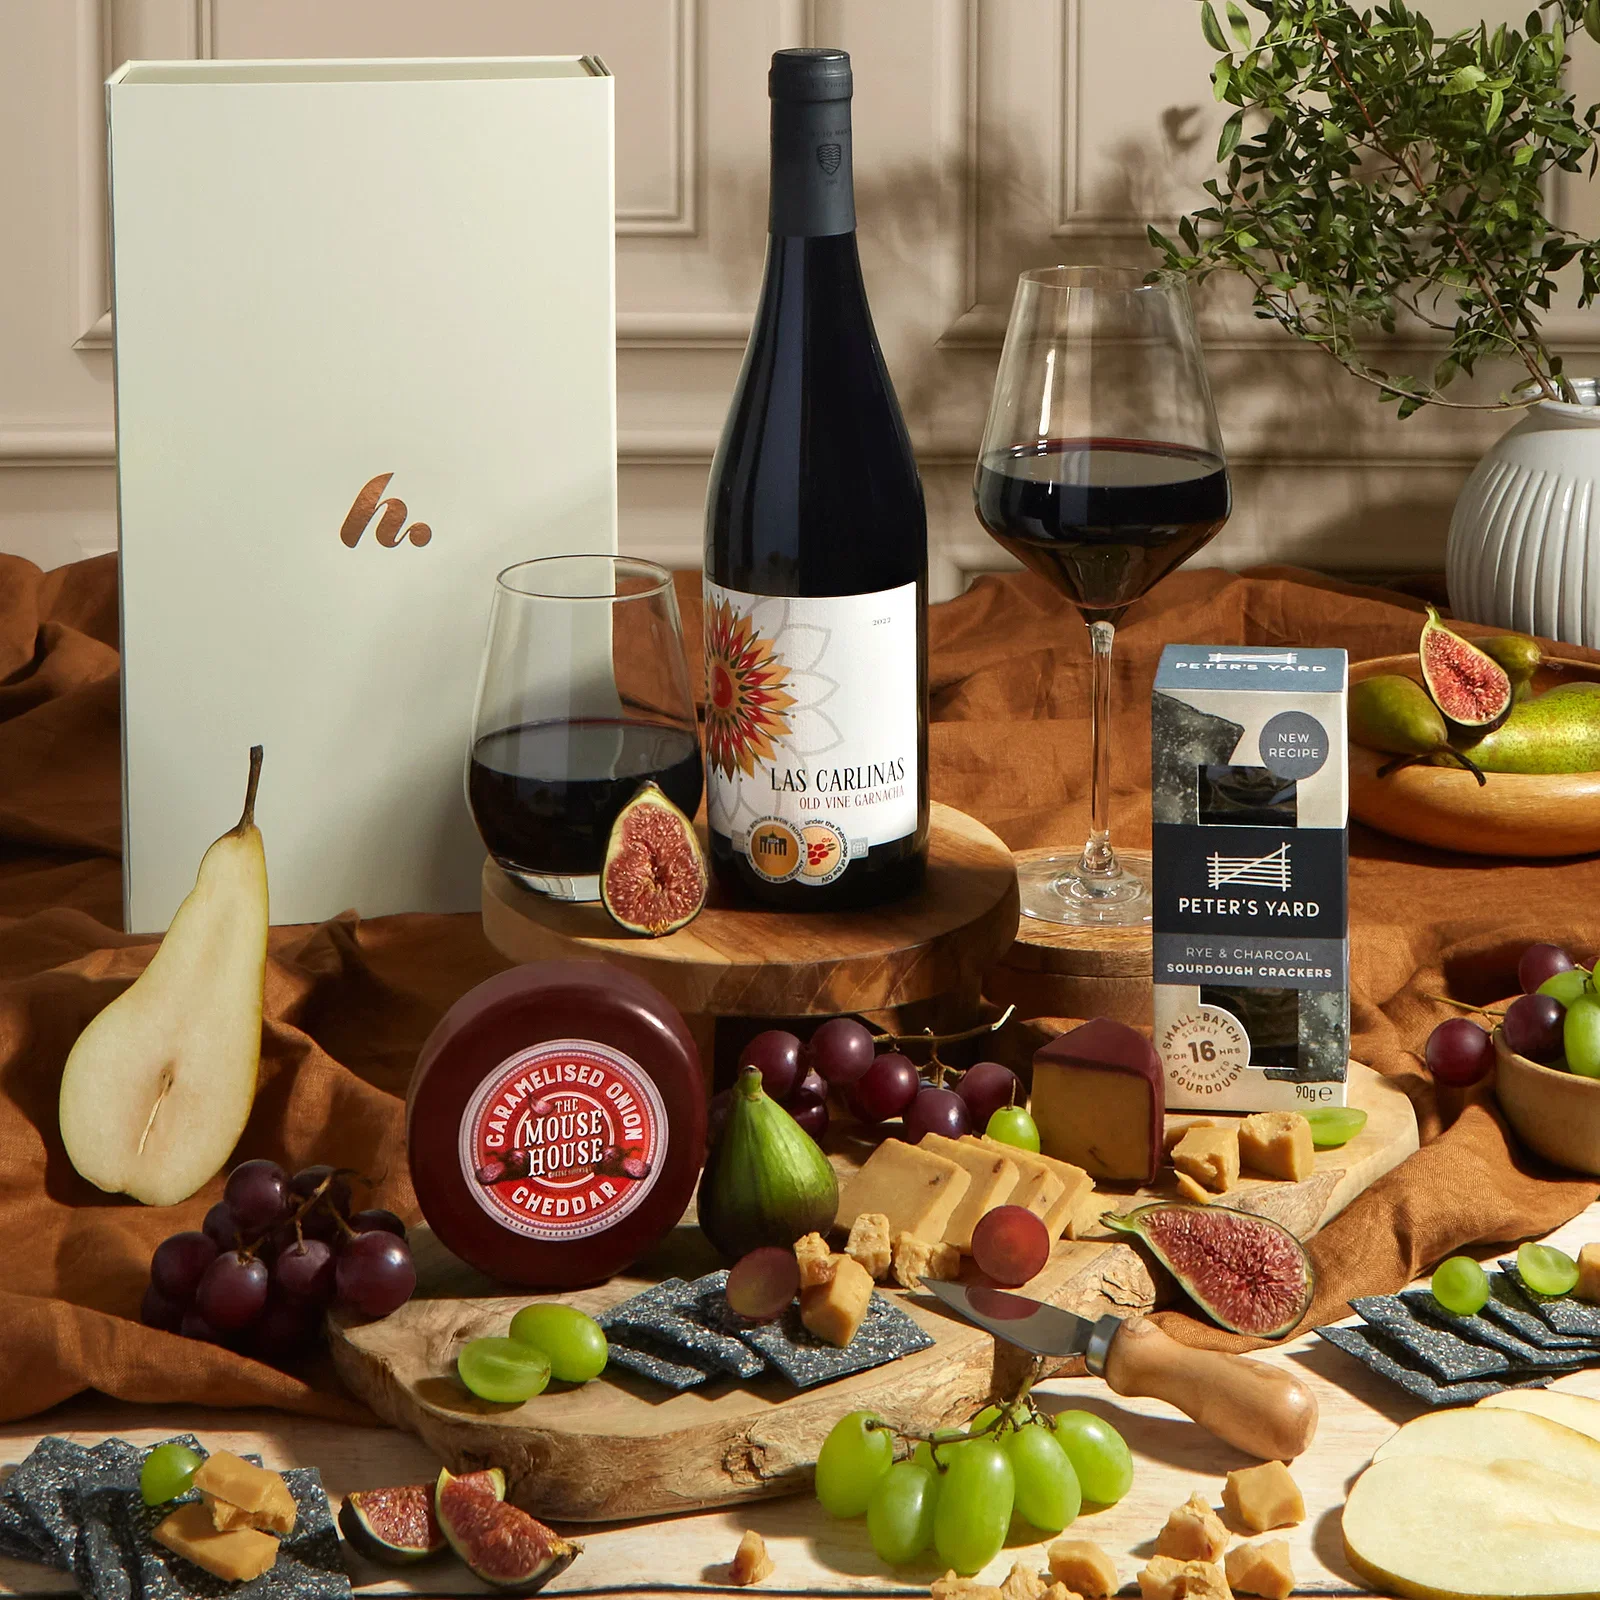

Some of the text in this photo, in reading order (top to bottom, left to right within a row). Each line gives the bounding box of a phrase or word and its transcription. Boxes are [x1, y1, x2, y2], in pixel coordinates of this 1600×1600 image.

[1175, 662, 1327, 672] PETER'S YARD
[1278, 733, 1310, 744] NEW
[1269, 748, 1319, 759] RECIPE
[771, 757, 905, 792] LAS CARLINAS
[799, 785, 905, 810] OLD VINE GARNACHA
[804, 818, 824, 826] under
[825, 820, 835, 829] the
[1178, 897, 1320, 918] PETER'S YARD
[1186, 947, 1313, 962] RYE & CHARCOAL
[1166, 963, 1332, 978] SOURDOUGH CRACKERS
[1162, 1012, 1242, 1050] SMALL-BATCH
[1181, 1025, 1219, 1038] SLOWLY
[1166, 1040, 1242, 1064] FOR 16 HRS
[1170, 1063, 1244, 1095] SOURDOUGH
[1181, 1060, 1230, 1081] FERMENTED
[1295, 1085, 1316, 1102] 90g
[486, 1064, 643, 1148] CARAMELISED ONION
[554, 1098, 579, 1113] THE
[524, 1109, 604, 1147] MOUSE
[528, 1137, 604, 1176] HOUSE
[511, 1181, 619, 1217] CHEDDAR
